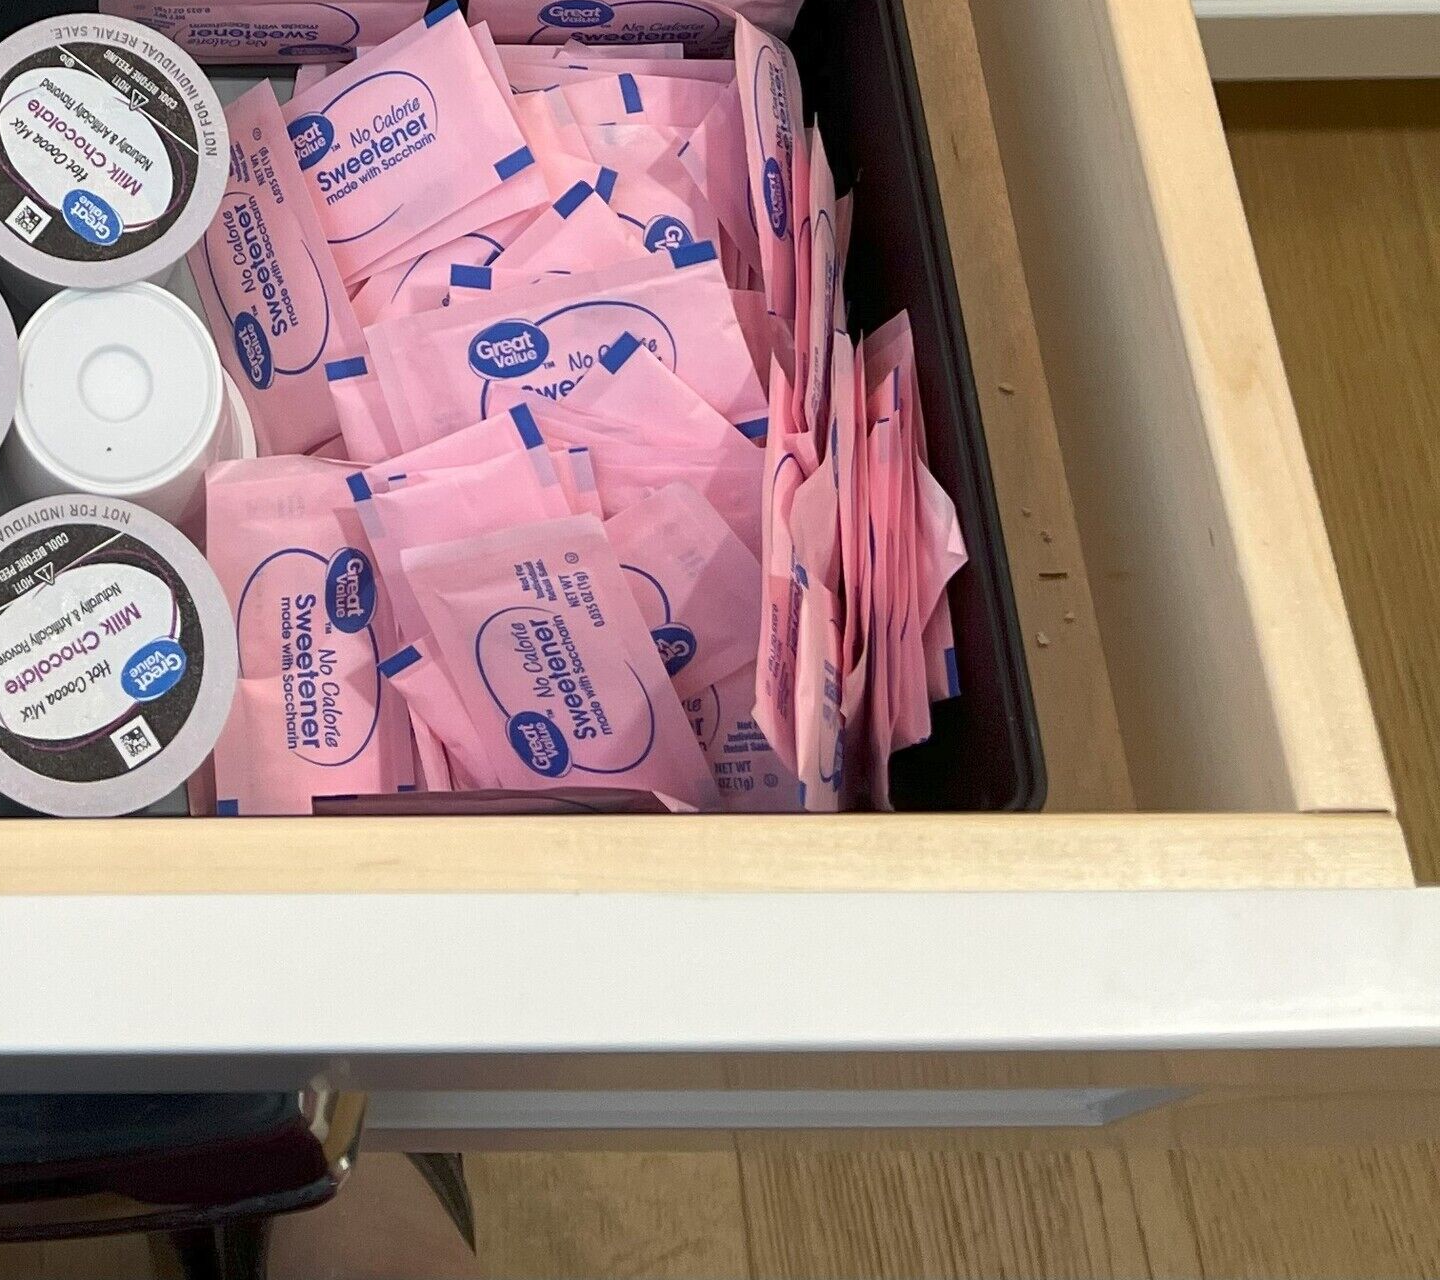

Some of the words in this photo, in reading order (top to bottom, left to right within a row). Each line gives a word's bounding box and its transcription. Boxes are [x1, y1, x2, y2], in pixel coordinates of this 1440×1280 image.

[27, 98, 108, 168] Chocolate
[349, 125, 372, 149] No
[372, 95, 423, 134] Calorie
[316, 113, 430, 193] Sweetener
[325, 181, 361, 206] made
[358, 167, 383, 188] with
[381, 133, 437, 171] Saccharin
[106, 167, 143, 197] Milk
[70, 200, 110, 240] Great
[78, 195, 109, 223] Value
[476, 331, 534, 358] Great
[493, 351, 537, 369] Value
[335, 572, 346, 619] Value
[344, 558, 365, 618] Great
[100, 601, 142, 636] Milk
[280, 596, 292, 640] made
[4, 630, 101, 695] Chocolate
[281, 641, 293, 670] with
[318, 648, 334, 675] No
[510, 622, 544, 674] Calorie
[47, 676, 88, 708] Cocoa
[84, 659, 112, 684] Hot
[295, 593, 321, 749] Sweetener
[528, 619, 597, 741] Sweetener
[533, 676, 555, 700] No
[19, 704, 48, 723] Mix
[282, 674, 298, 750] Saccharin
[320, 680, 341, 748] Calorie
